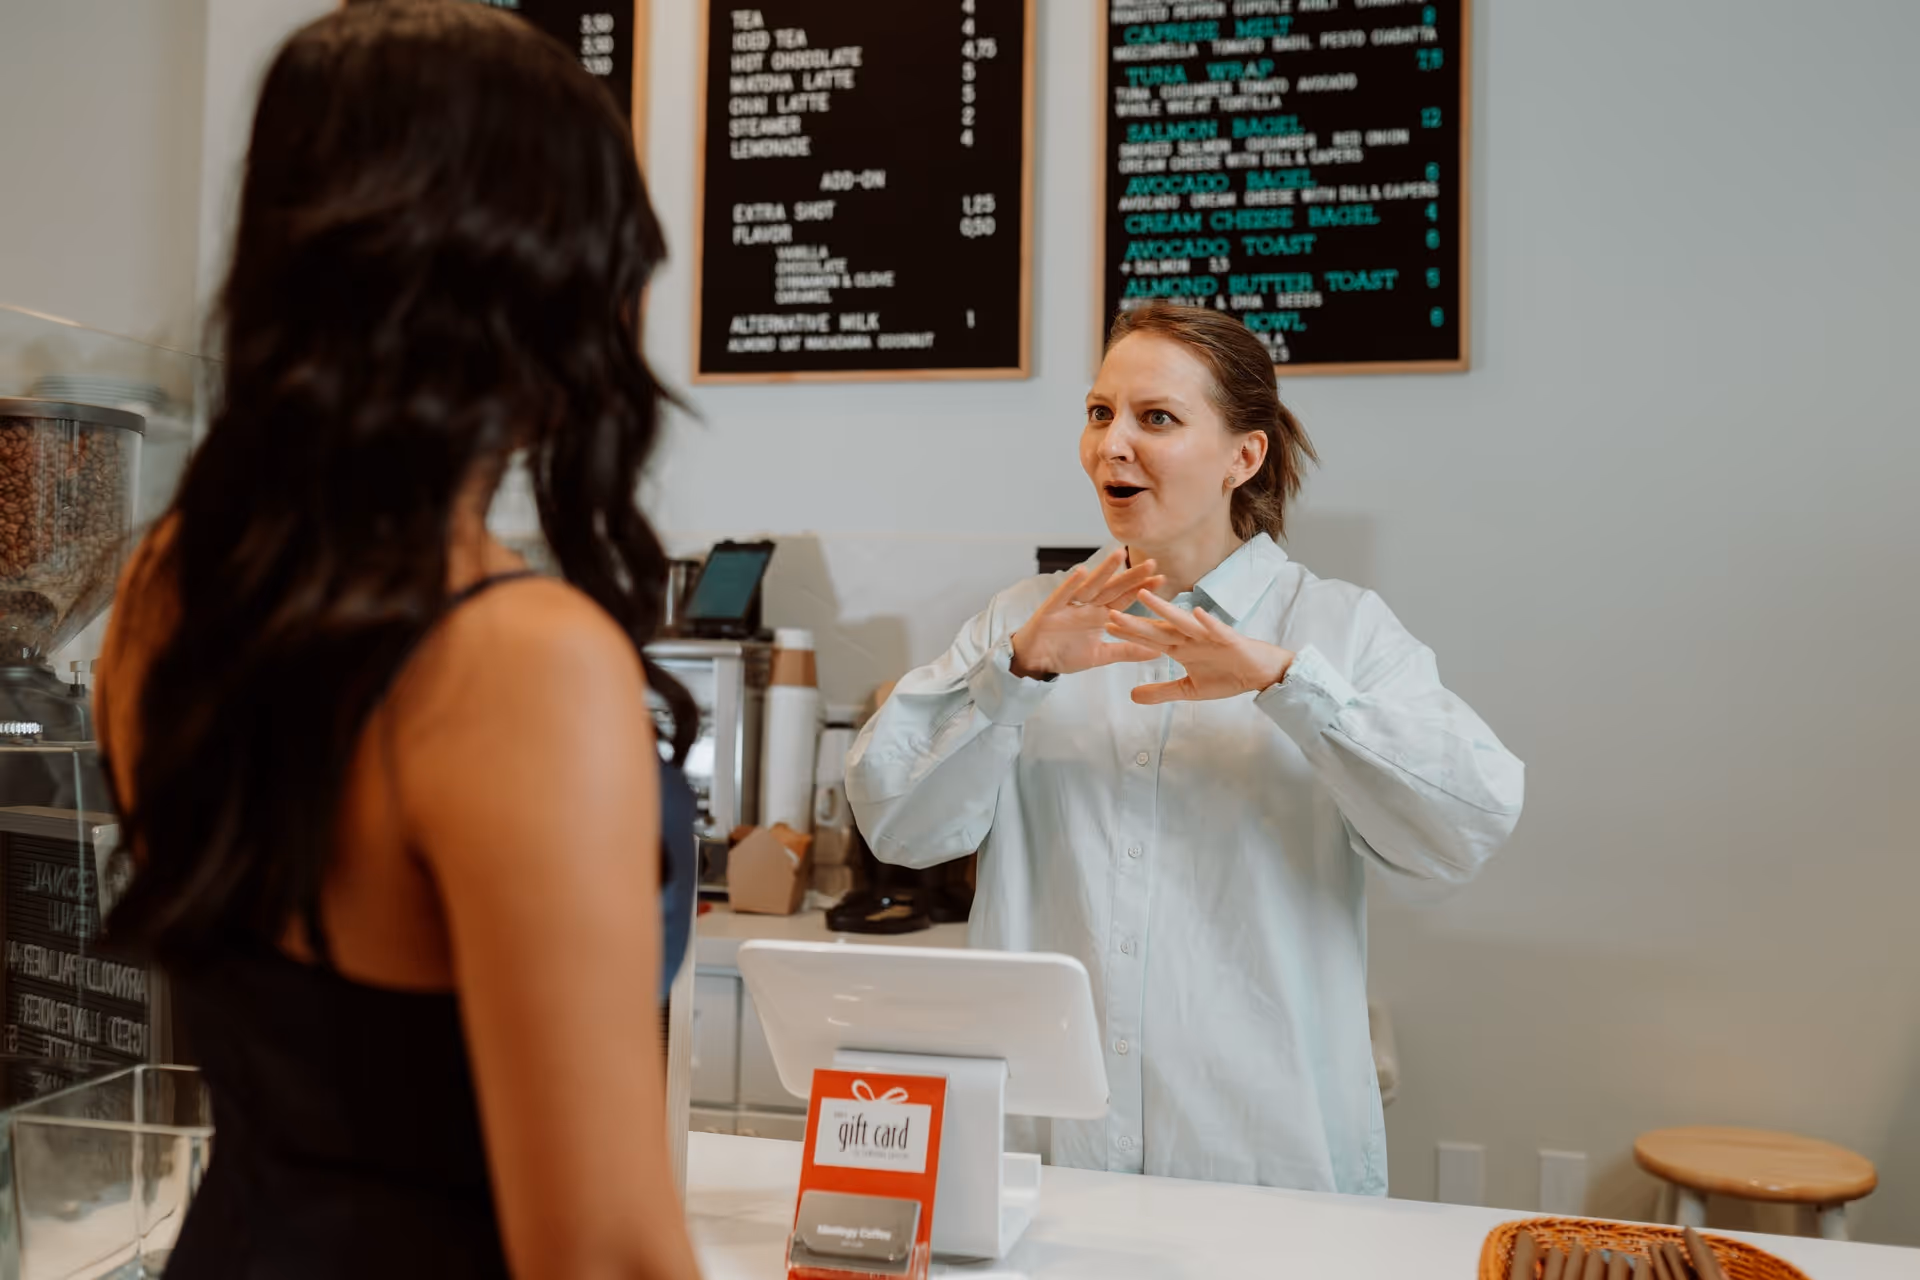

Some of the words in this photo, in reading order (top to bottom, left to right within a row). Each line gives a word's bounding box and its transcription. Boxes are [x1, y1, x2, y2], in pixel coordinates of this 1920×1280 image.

[730, 10, 764, 30] TEA
[1234, 15, 1293, 38] MELT
[733, 30, 770, 51] ICED
[773, 28, 807, 49] TEA
[961, 17, 976, 36] 4
[731, 52, 765, 72] HOT
[770, 46, 862, 71] CHOCOLATE
[730, 73, 794, 94] MATCHA
[802, 69, 855, 91] LATTE
[1124, 64, 1188, 88] TUNA
[1205, 58, 1275, 82] WRAP
[729, 95, 768, 116] CHAI
[776, 92, 830, 114] LATTE
[729, 115, 801, 138] STEAMER
[1127, 119, 1218, 143] SALMON
[1232, 113, 1305, 138] BAGEL
[730, 136, 811, 160] LEMONADE
[960, 127, 974, 147] 4
[819, 169, 886, 191] ADD-ON
[1125, 173, 1230, 197] AVOCADO
[1246, 168, 1318, 191] BAGEL
[732, 203, 786, 224] EXTRA
[793, 200, 836, 221] SHOT
[1124, 211, 1202, 234] CREAM
[1209, 207, 1294, 231] CHEESE
[1308, 204, 1381, 227] BAGEL
[1424, 202, 1438, 222] 4
[732, 224, 793, 245] FLAVOR
[1124, 237, 1231, 261] AVOCADO
[1241, 233, 1318, 256] TOAST
[1124, 275, 1219, 298] ALMOND
[1228, 271, 1314, 295] BUTTER
[1323, 269, 1399, 292] TOAST
[730, 313, 831, 335] ALTERNATIVE
[839, 312, 880, 332] MILK
[838, 1112, 869, 1152] gift
[874, 1116, 910, 1150] card
